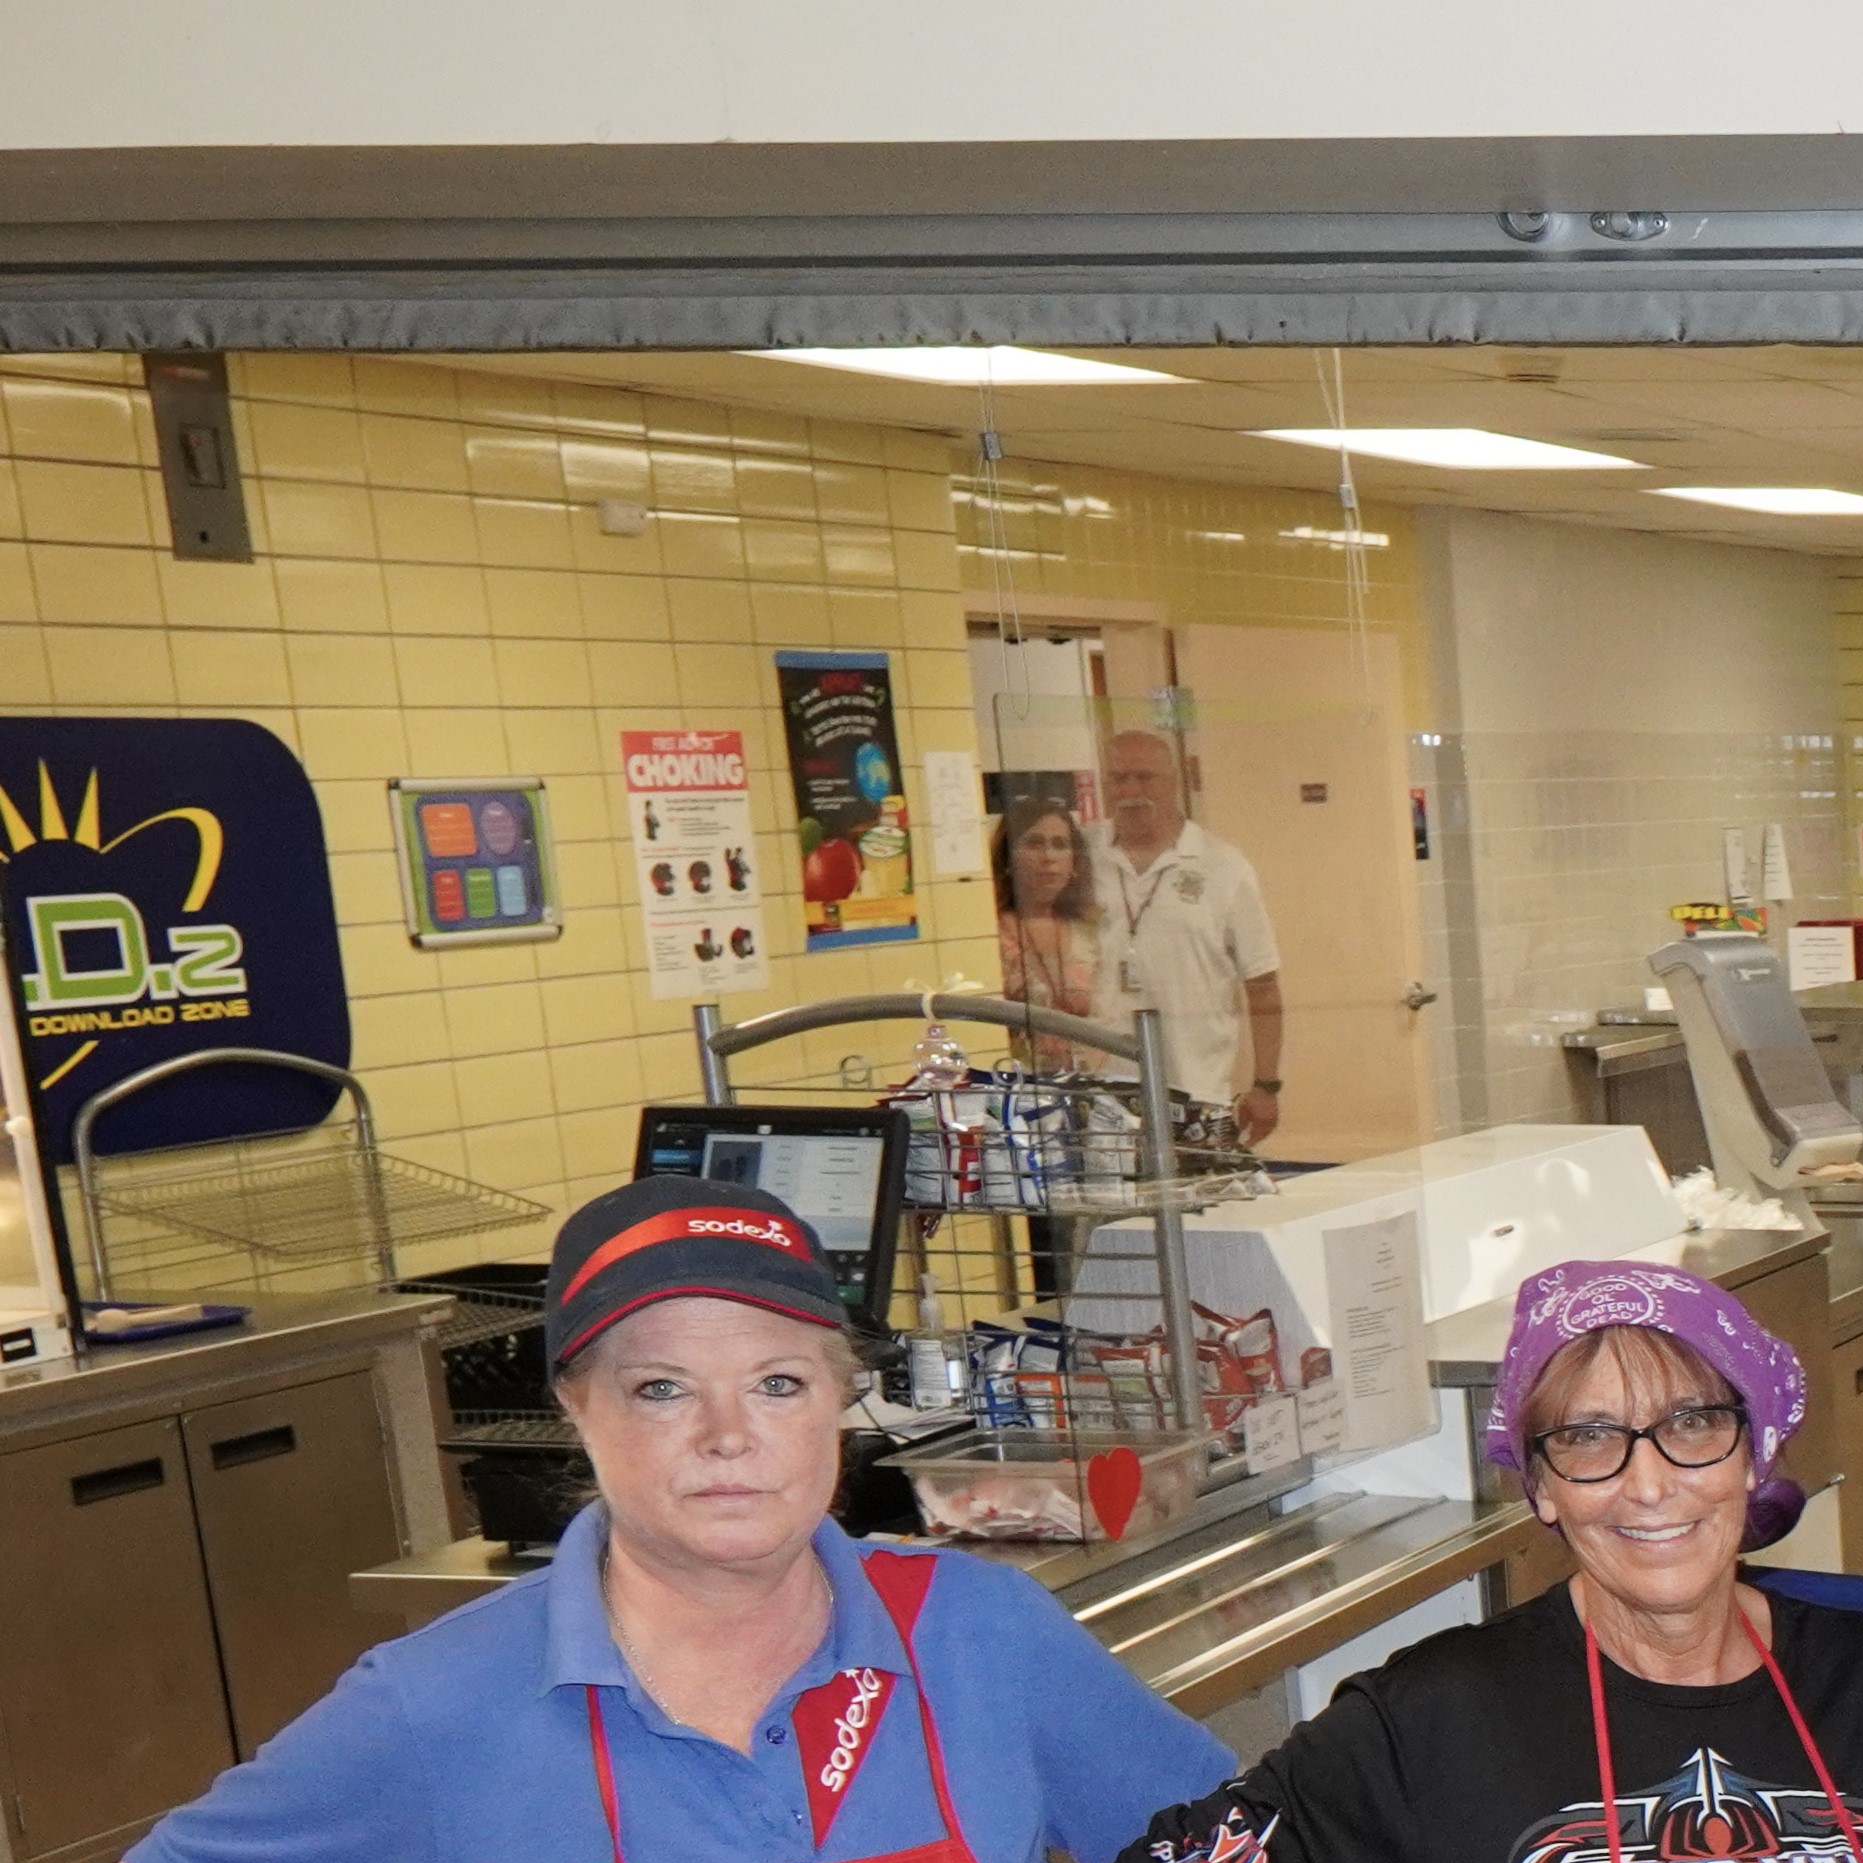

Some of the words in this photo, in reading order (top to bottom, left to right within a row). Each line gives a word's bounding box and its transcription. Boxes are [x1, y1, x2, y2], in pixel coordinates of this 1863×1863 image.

[627, 753, 744, 788] CHOKING
[29, 1005, 175, 1037] DOWNLOAD
[180, 998, 250, 1023] ZONE
[688, 1219, 792, 1247] sodexo
[1579, 1283, 1628, 1300] GOOD
[1571, 1302, 1646, 1324] GRATEFUL
[1586, 1311, 1633, 1328] DEAD
[821, 1666, 882, 1792] sodexo
